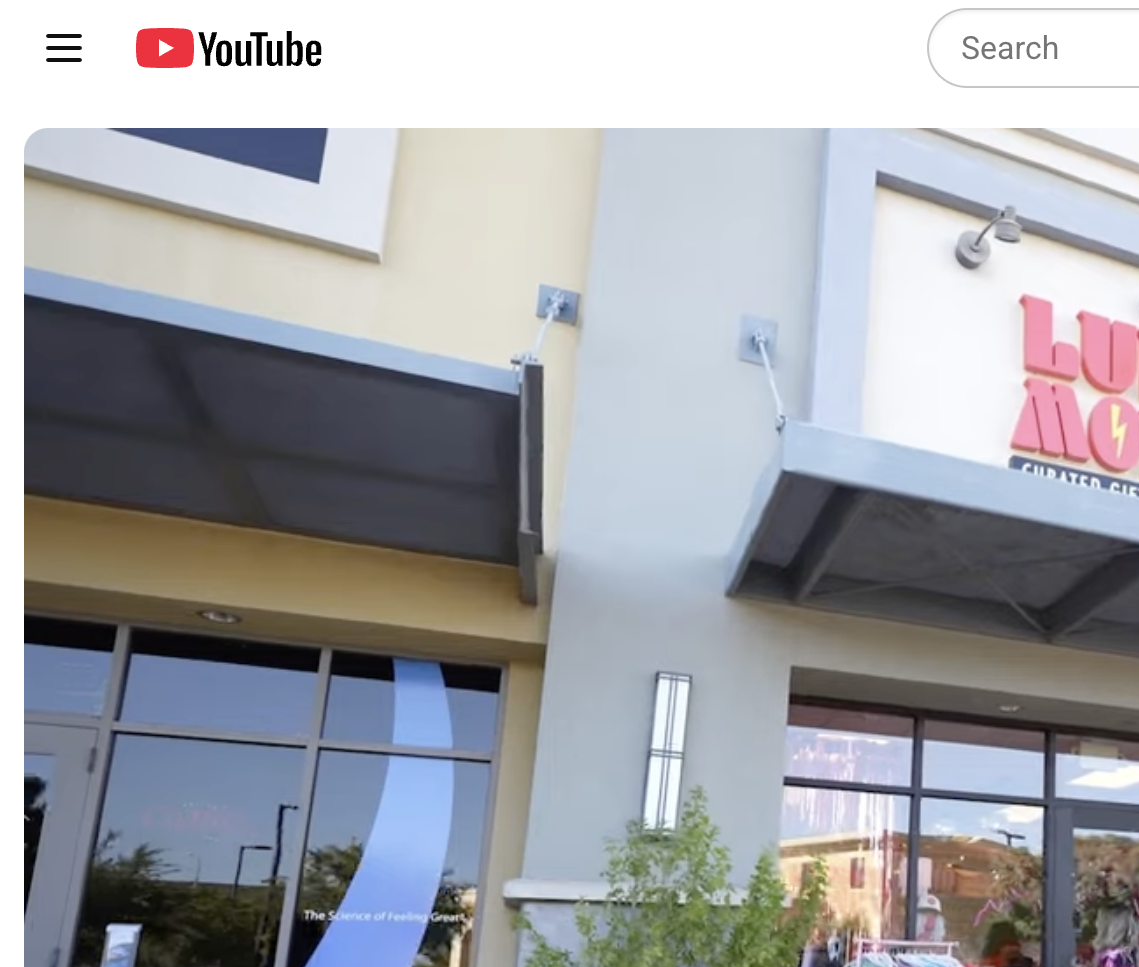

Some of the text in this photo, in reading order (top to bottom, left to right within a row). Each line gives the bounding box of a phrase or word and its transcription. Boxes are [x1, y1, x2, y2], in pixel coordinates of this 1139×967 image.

[197, 30, 323, 68] YouTube
[961, 34, 1058, 60] Search
[303, 910, 326, 921] The
[328, 911, 371, 921] Science
[374, 911, 387, 921] of
[388, 911, 428, 923] Feeling
